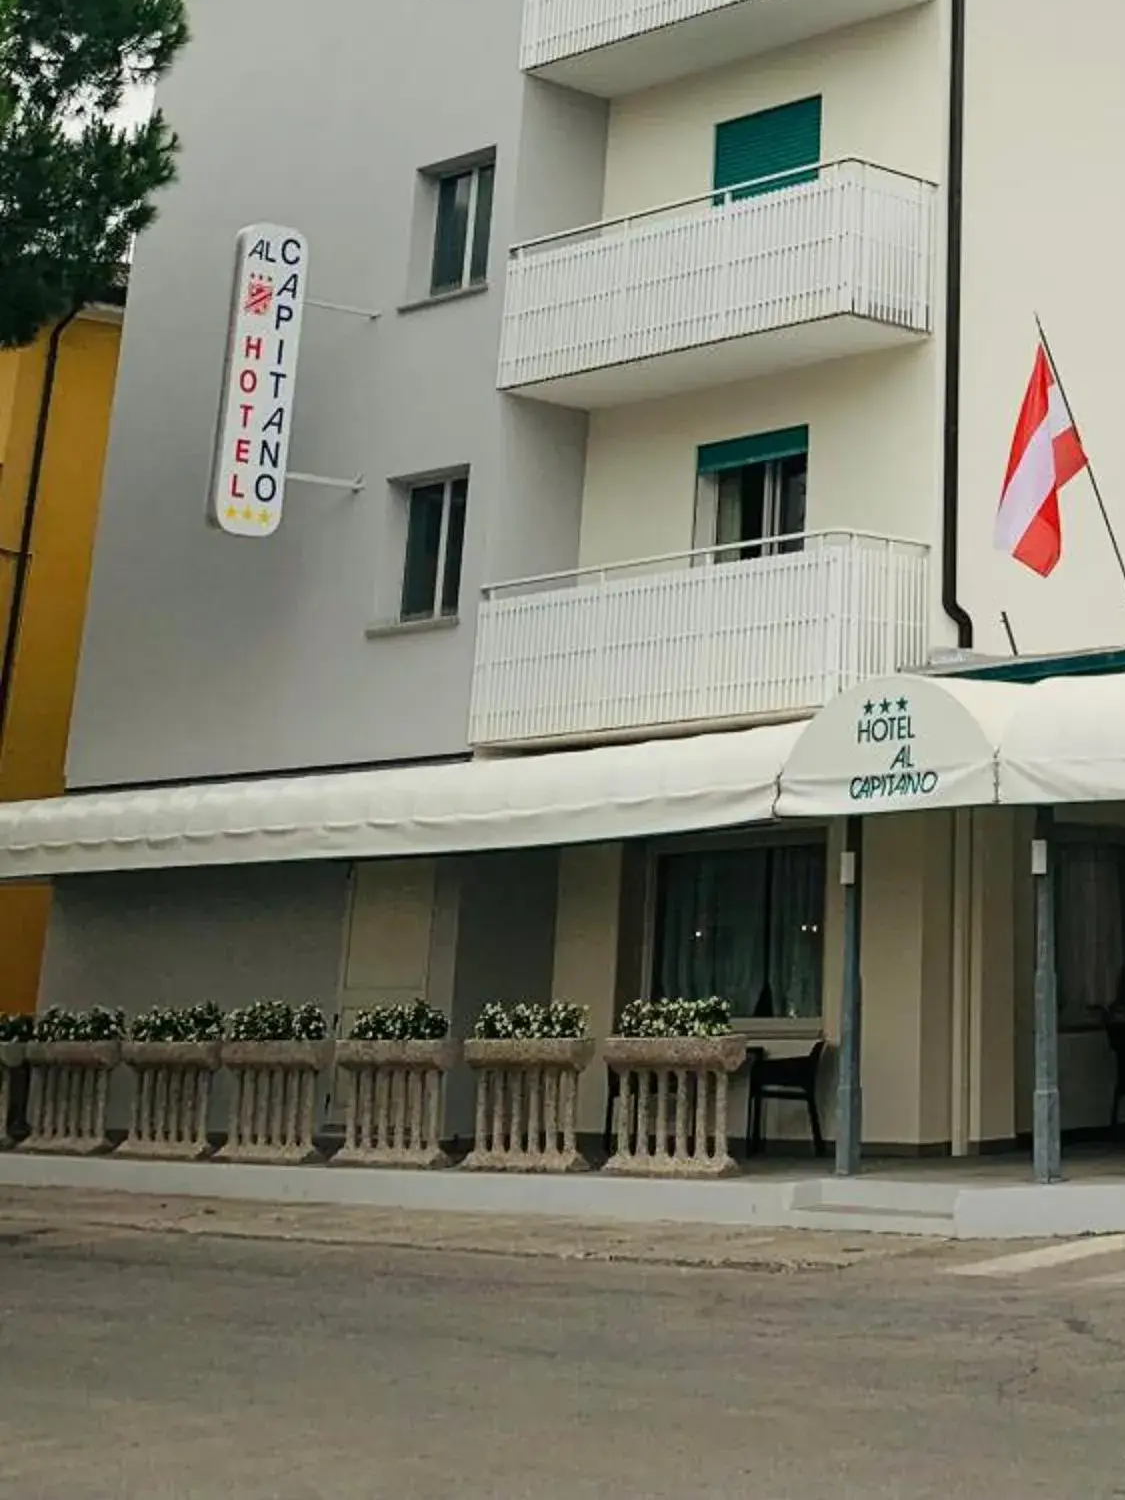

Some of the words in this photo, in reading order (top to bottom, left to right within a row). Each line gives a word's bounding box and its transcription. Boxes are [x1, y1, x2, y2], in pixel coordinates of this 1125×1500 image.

[249, 239, 276, 263] AL
[255, 238, 301, 503] CAPITANO
[230, 336, 262, 499] HOTEL
[857, 715, 915, 744] HOTEL
[890, 744, 914, 770] AL
[850, 769, 938, 800] CAPITANO
